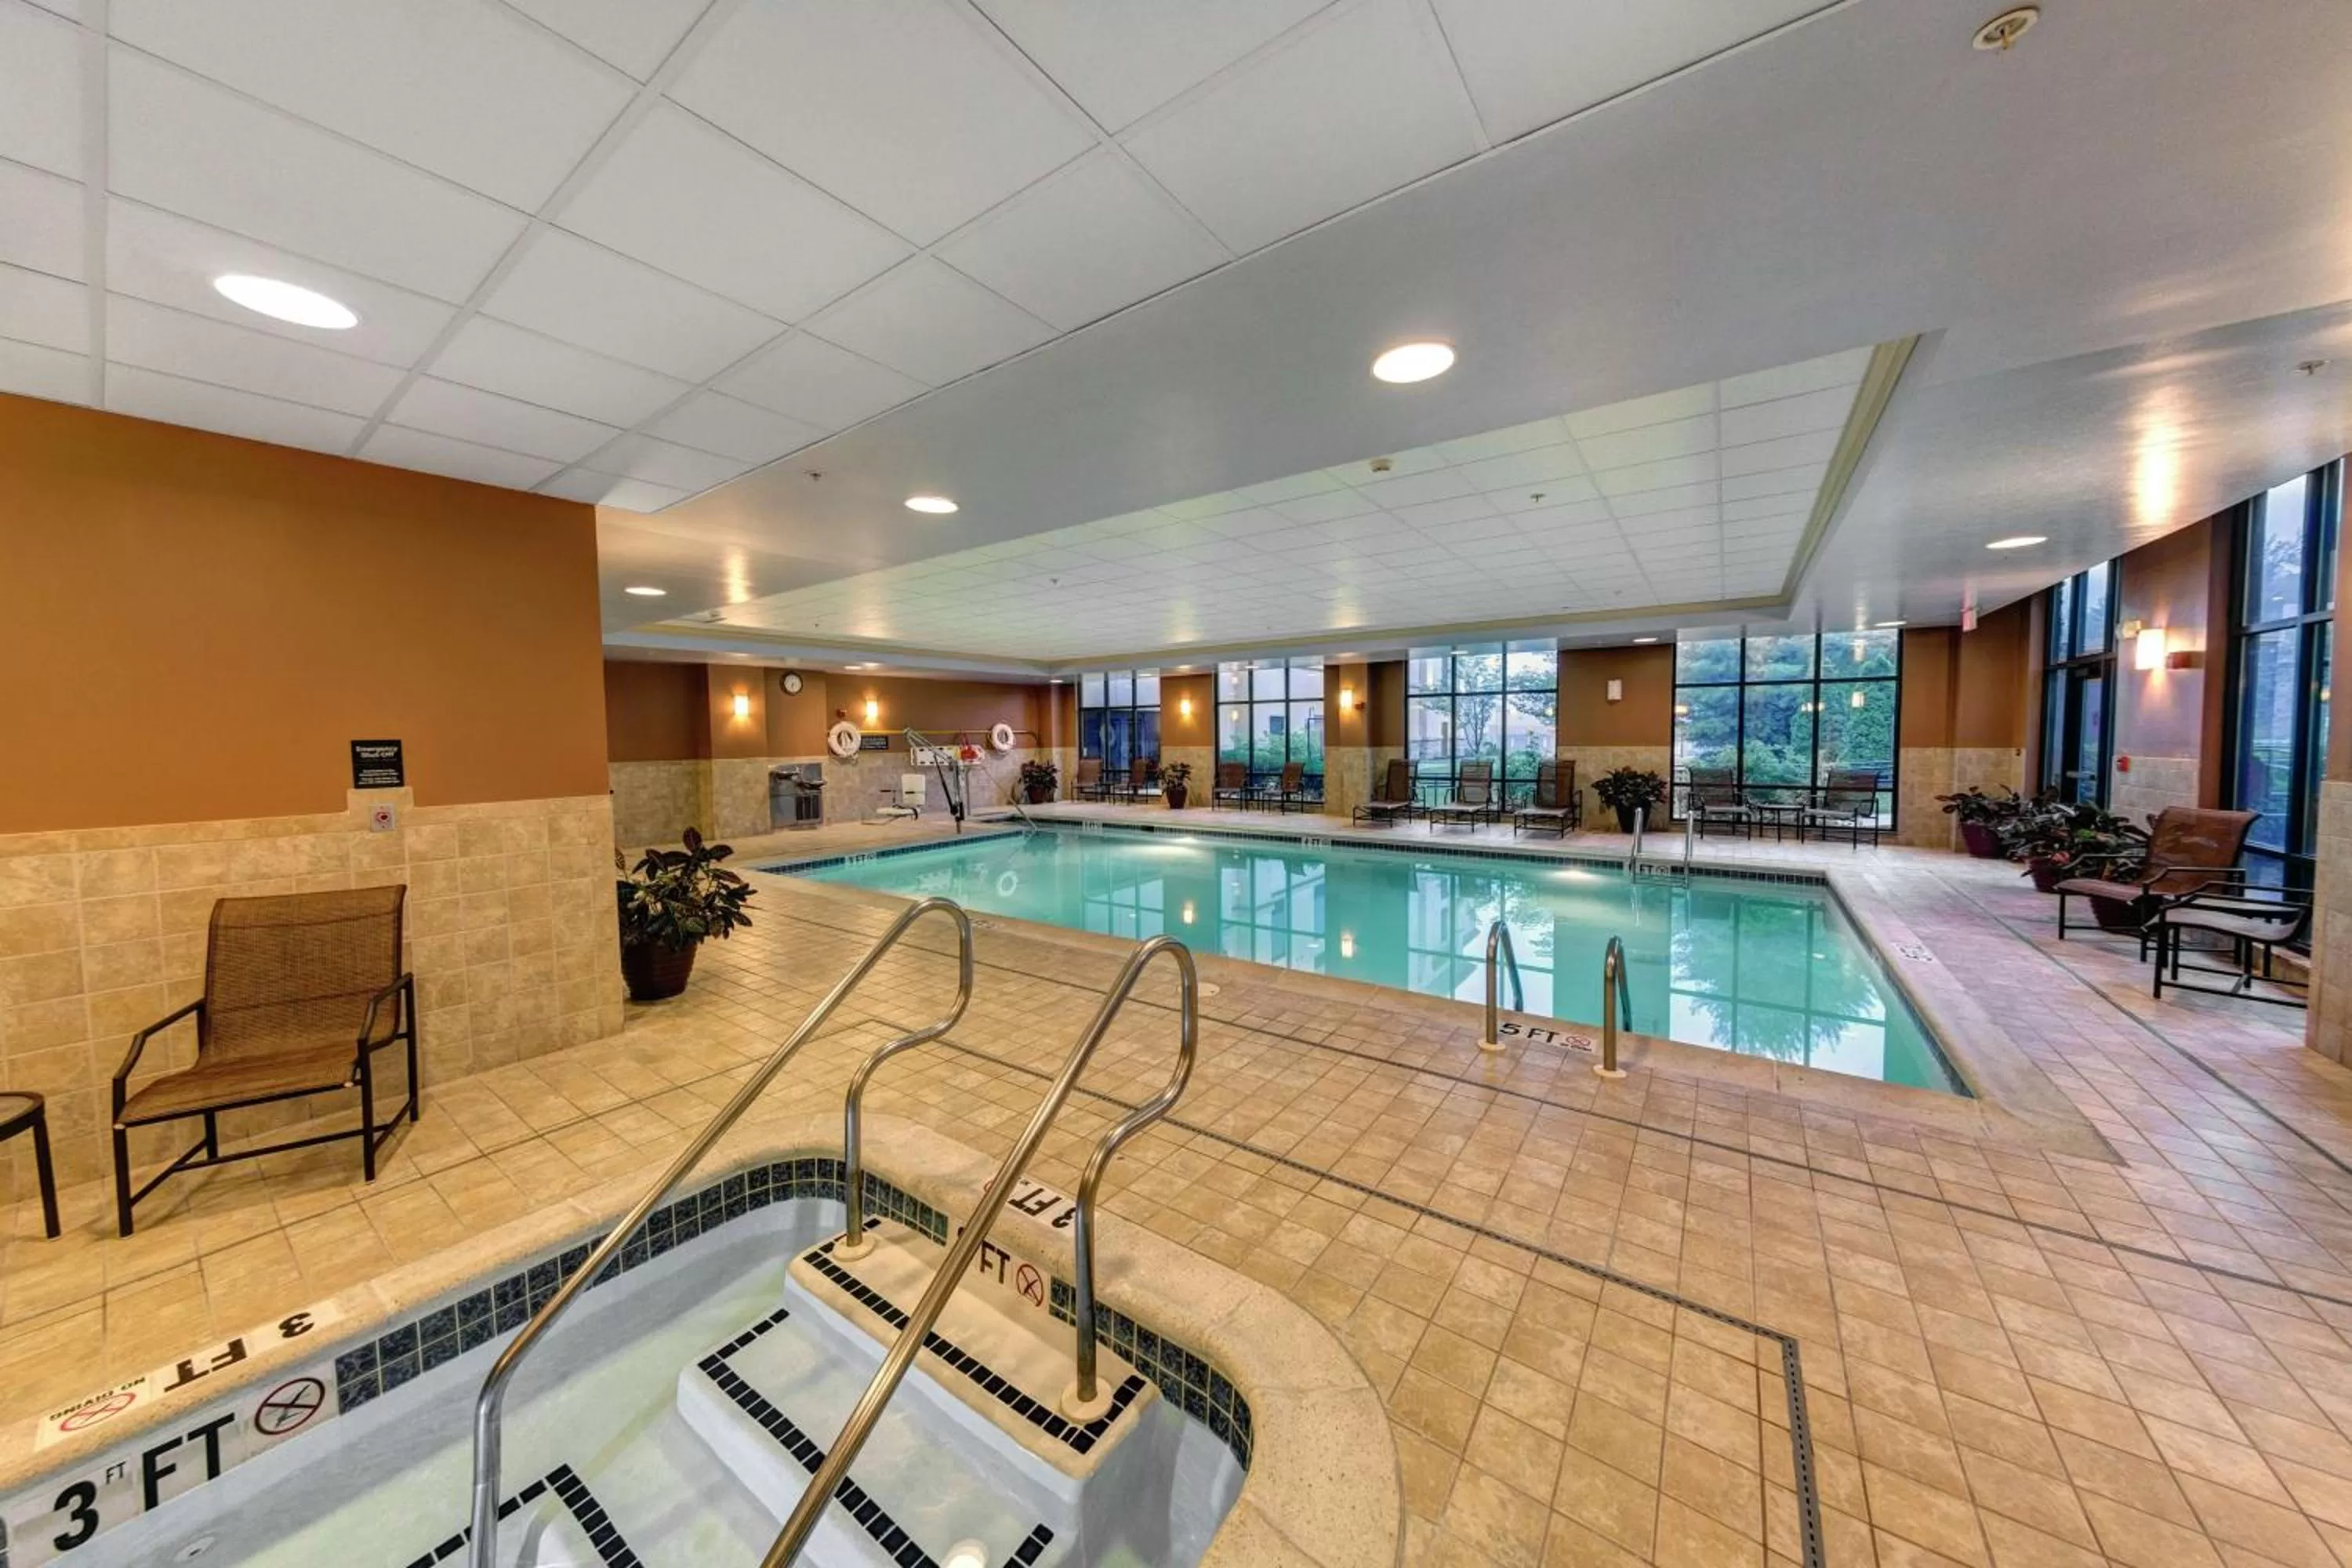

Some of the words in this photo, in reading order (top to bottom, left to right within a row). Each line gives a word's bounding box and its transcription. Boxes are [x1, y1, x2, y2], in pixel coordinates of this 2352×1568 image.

[1527, 1028, 1559, 1044] FT
[1008, 1188, 1063, 1217] FT
[980, 1239, 1011, 1284] FT
[278, 1312, 314, 1338] 3
[164, 1338, 247, 1392] FT
[121, 1377, 146, 1390] NO
[49, 1390, 114, 1421] DIVING
[142, 1412, 235, 1512] FT
[53, 1479, 100, 1552] 3
[106, 1461, 126, 1485] FT
